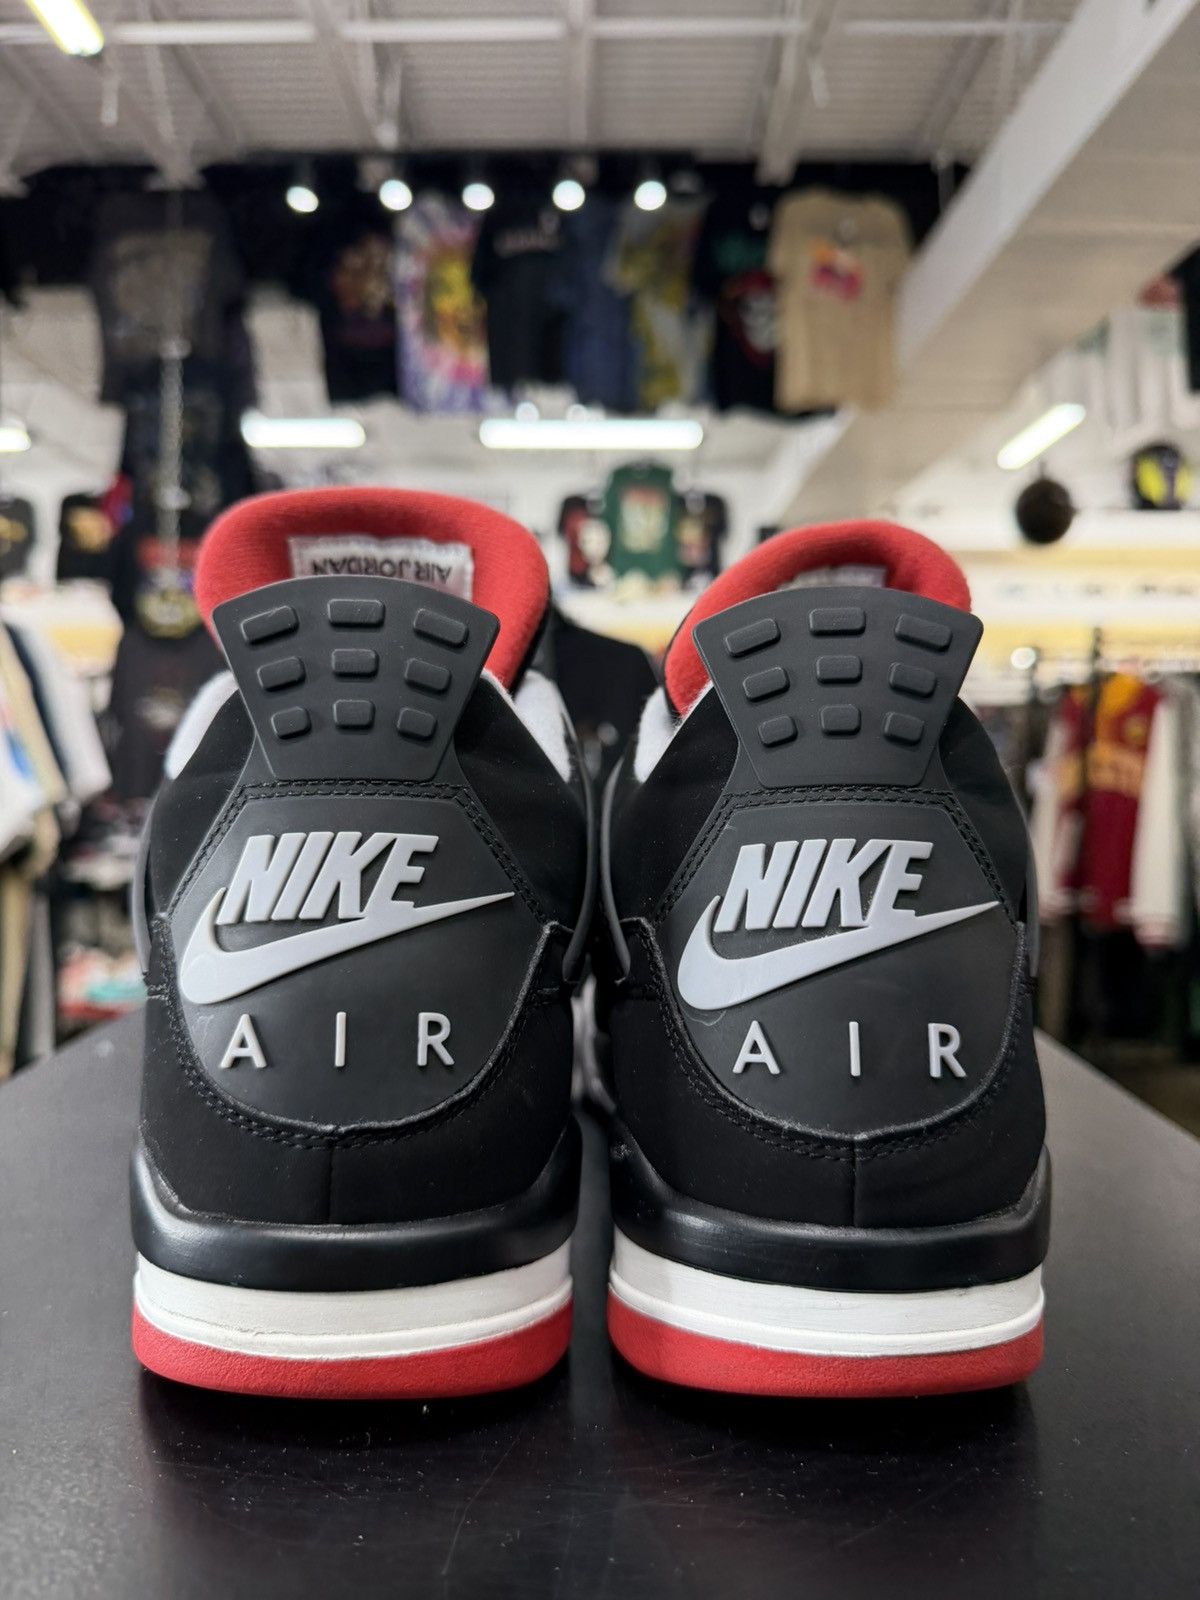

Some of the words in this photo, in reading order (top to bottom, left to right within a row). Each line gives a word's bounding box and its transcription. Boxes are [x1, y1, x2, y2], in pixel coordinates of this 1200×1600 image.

[312, 555, 411, 578] JORDAN
[414, 559, 453, 585] AIR
[216, 831, 439, 925] NIKE
[714, 838, 933, 932] NIKE
[220, 1011, 455, 1068] AIR
[732, 1020, 967, 1078] AIR
